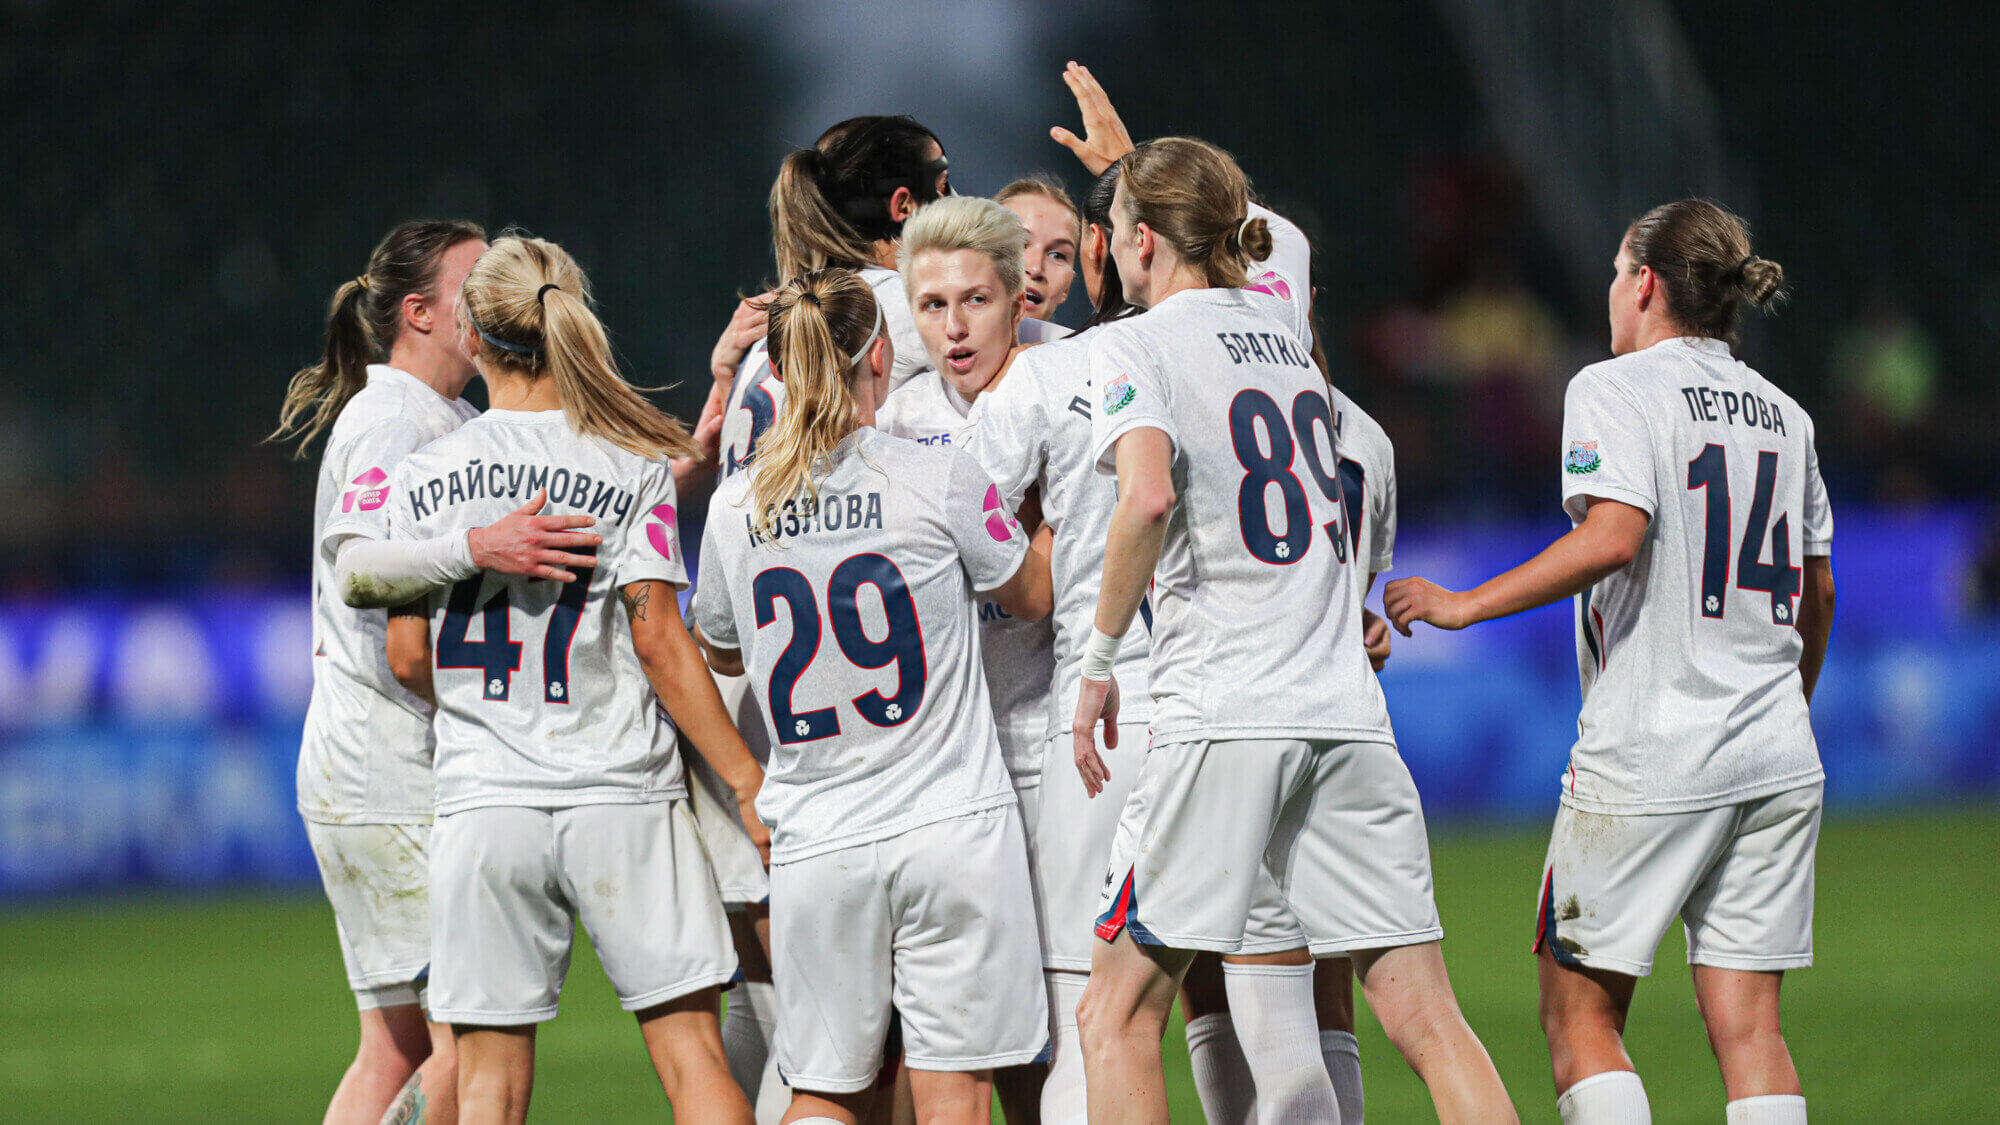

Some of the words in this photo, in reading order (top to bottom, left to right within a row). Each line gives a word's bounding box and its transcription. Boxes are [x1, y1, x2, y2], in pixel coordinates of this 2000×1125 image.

[1216, 332, 1310, 369] БРАТКО
[409, 459, 634, 527] КРАЙСУМОВИЧ
[1228, 388, 1347, 565] 89
[1687, 443, 1802, 626] 14
[436, 531, 598, 704] 47
[752, 552, 928, 745] 29
